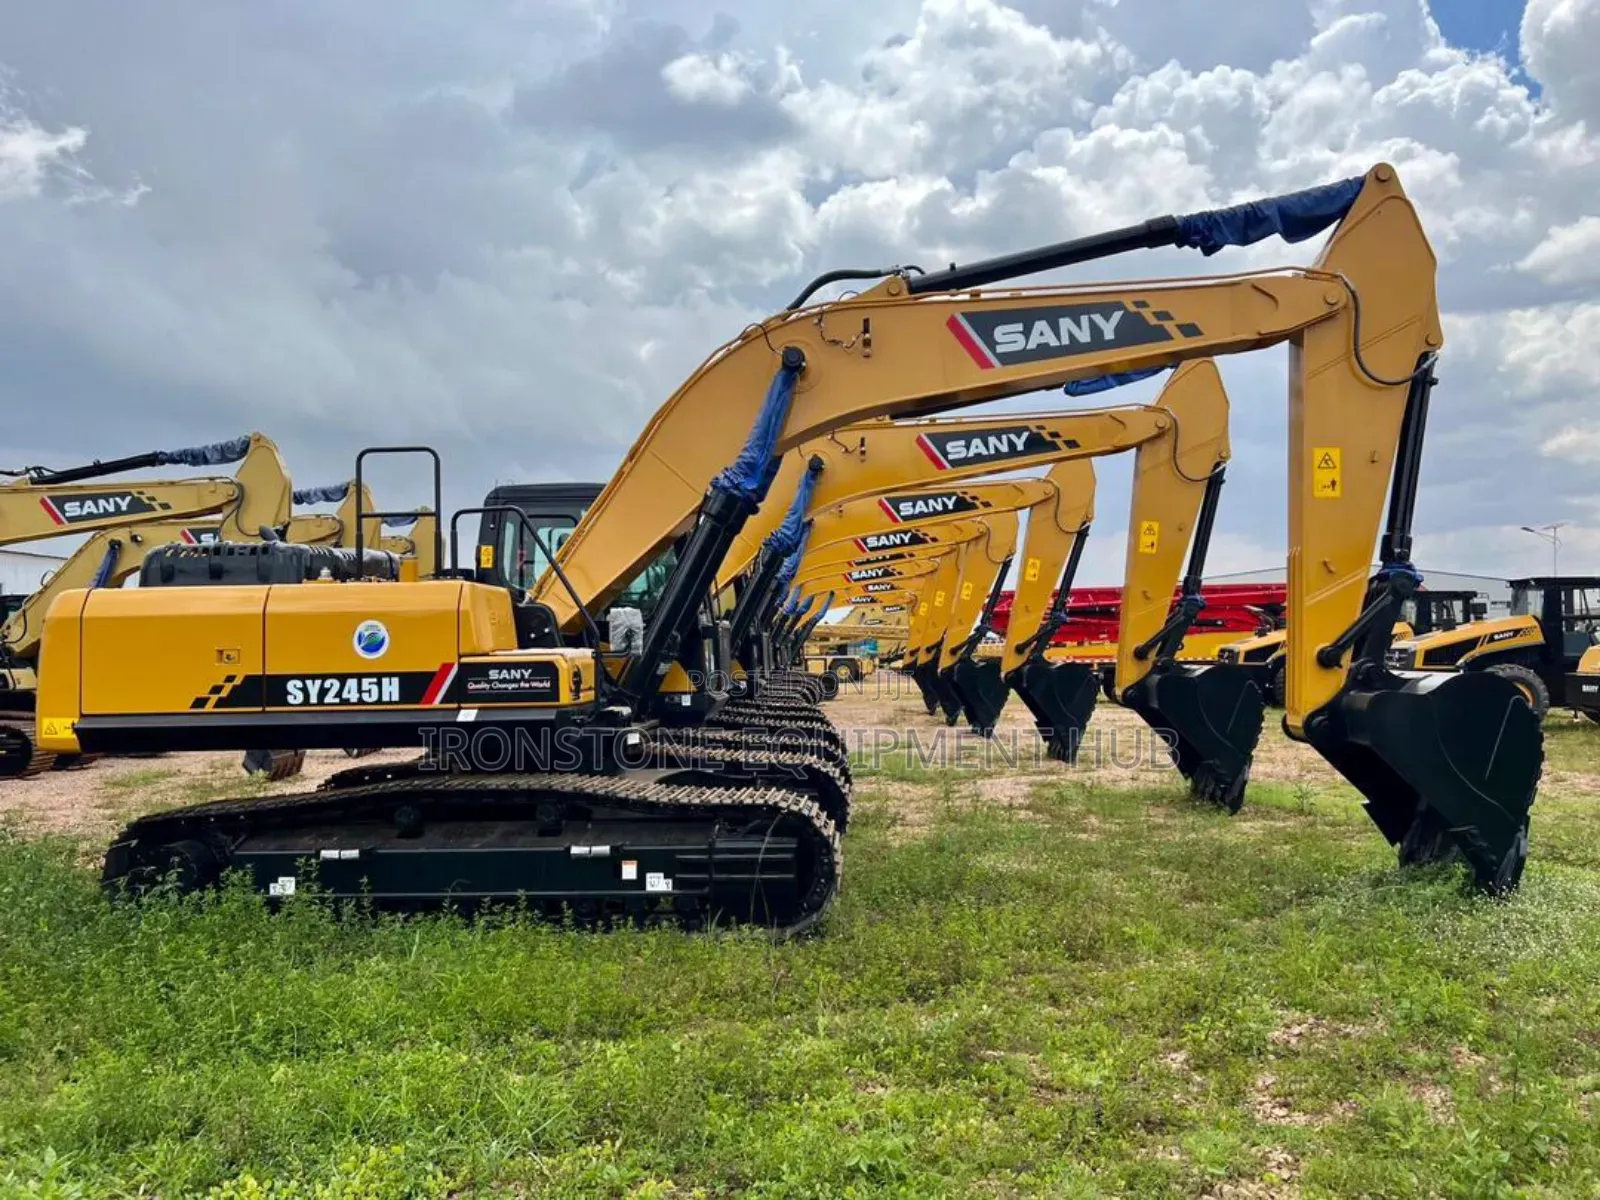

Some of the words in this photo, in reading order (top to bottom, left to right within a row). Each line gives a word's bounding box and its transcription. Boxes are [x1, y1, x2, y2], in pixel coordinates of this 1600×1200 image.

[994, 310, 1124, 354] SANY
[946, 431, 1030, 460] SANY
[64, 496, 132, 517] SANY
[899, 496, 957, 516] SANY
[866, 532, 912, 548] SANY
[851, 568, 884, 580] SANY
[867, 584, 892, 592] SANY
[488, 669, 532, 680] SANY
[286, 677, 400, 704] SY245H
[467, 681, 490, 691] Quality
[492, 681, 519, 690] Changes
[530, 680, 551, 688] World
